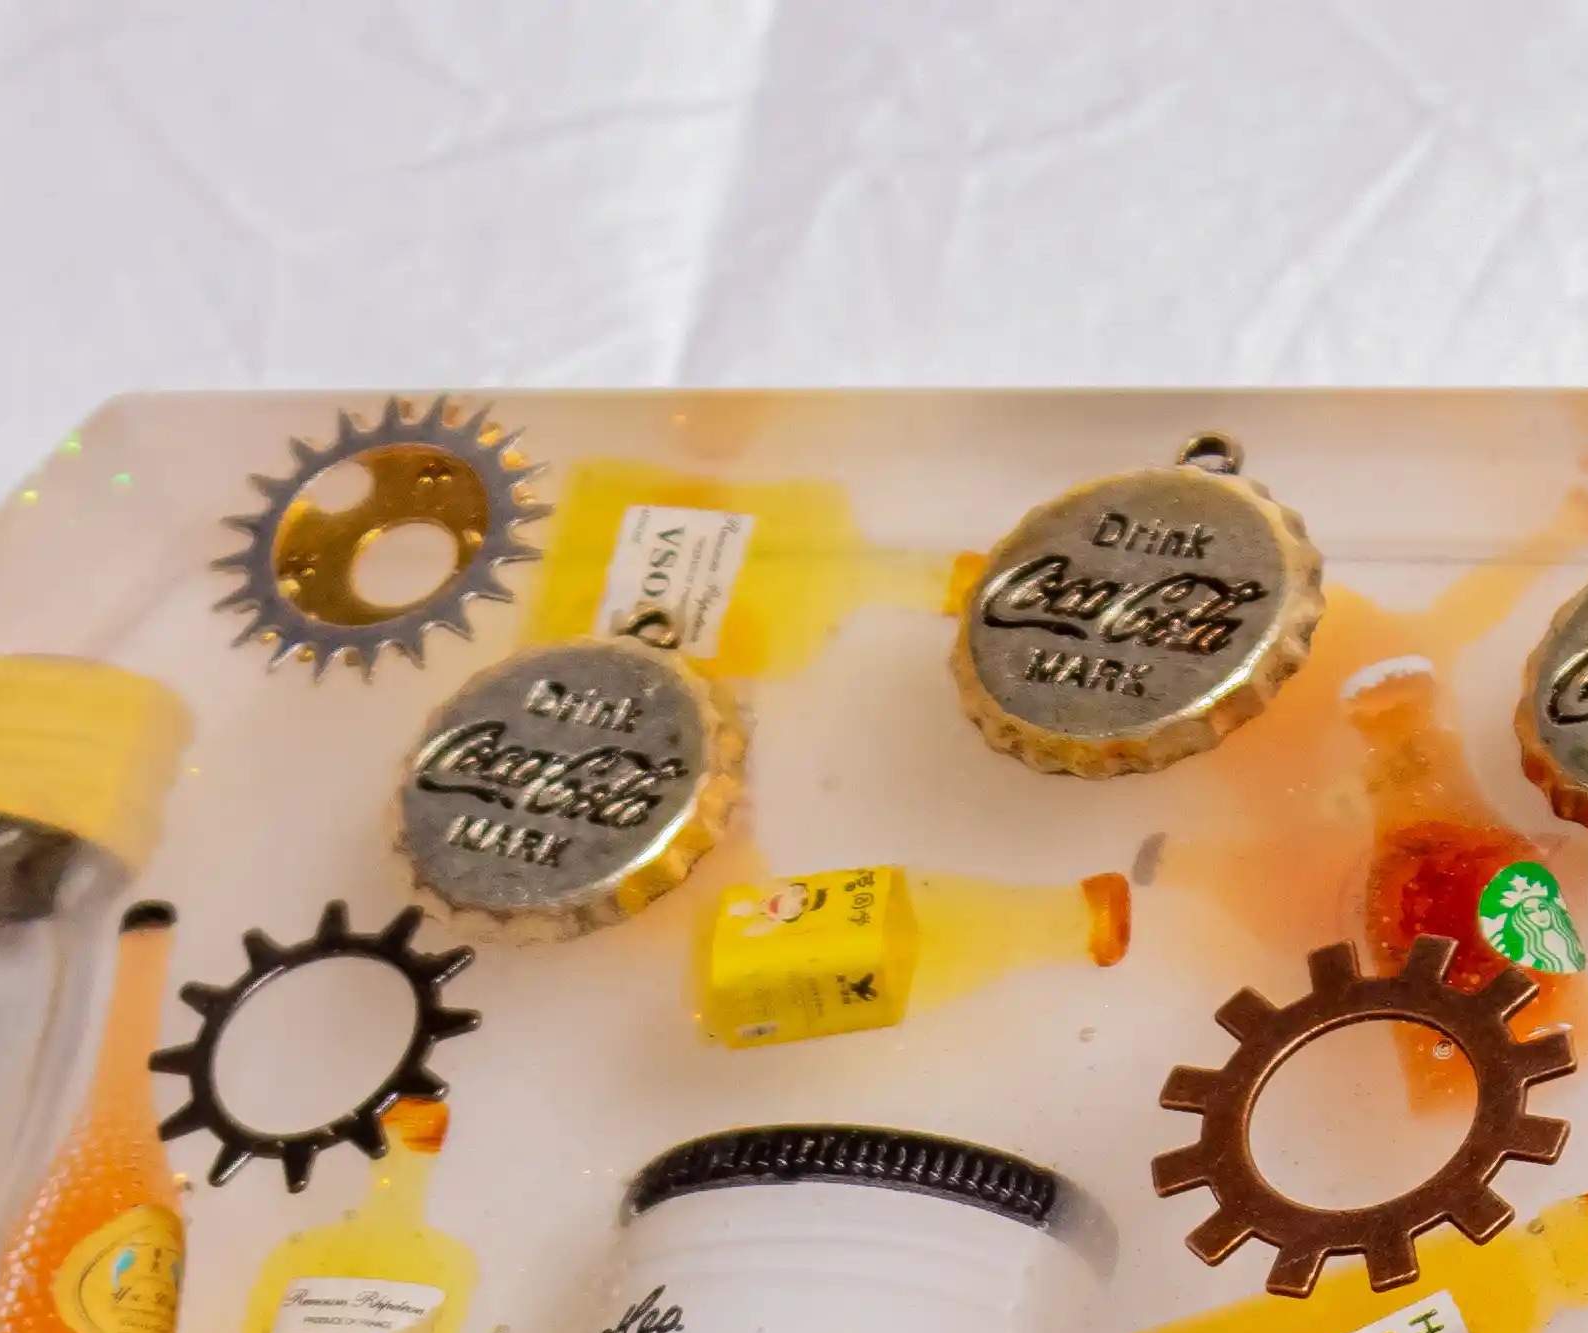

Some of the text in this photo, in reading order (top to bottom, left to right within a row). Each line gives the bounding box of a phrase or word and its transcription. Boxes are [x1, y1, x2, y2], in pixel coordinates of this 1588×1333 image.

[638, 521, 686, 606] VSO
[1092, 512, 1215, 561] Drink
[1024, 647, 1152, 697] MARK
[522, 677, 643, 733] Drink
[447, 812, 571, 870] MARK
